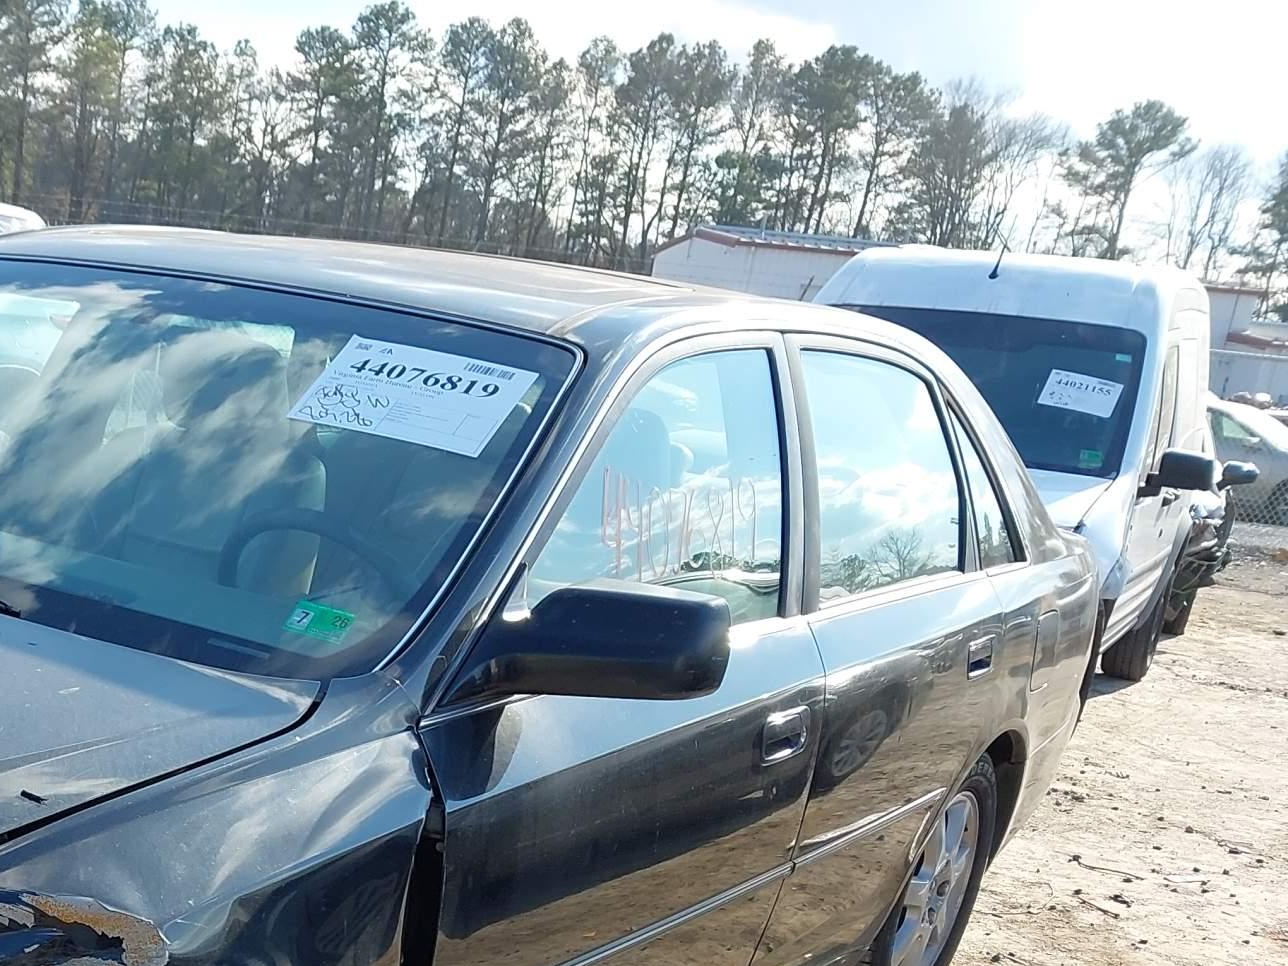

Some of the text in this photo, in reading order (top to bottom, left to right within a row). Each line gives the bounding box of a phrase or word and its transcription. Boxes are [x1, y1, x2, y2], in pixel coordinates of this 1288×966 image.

[349, 358, 501, 399] 44076819
[296, 610, 350, 629] 7 26
